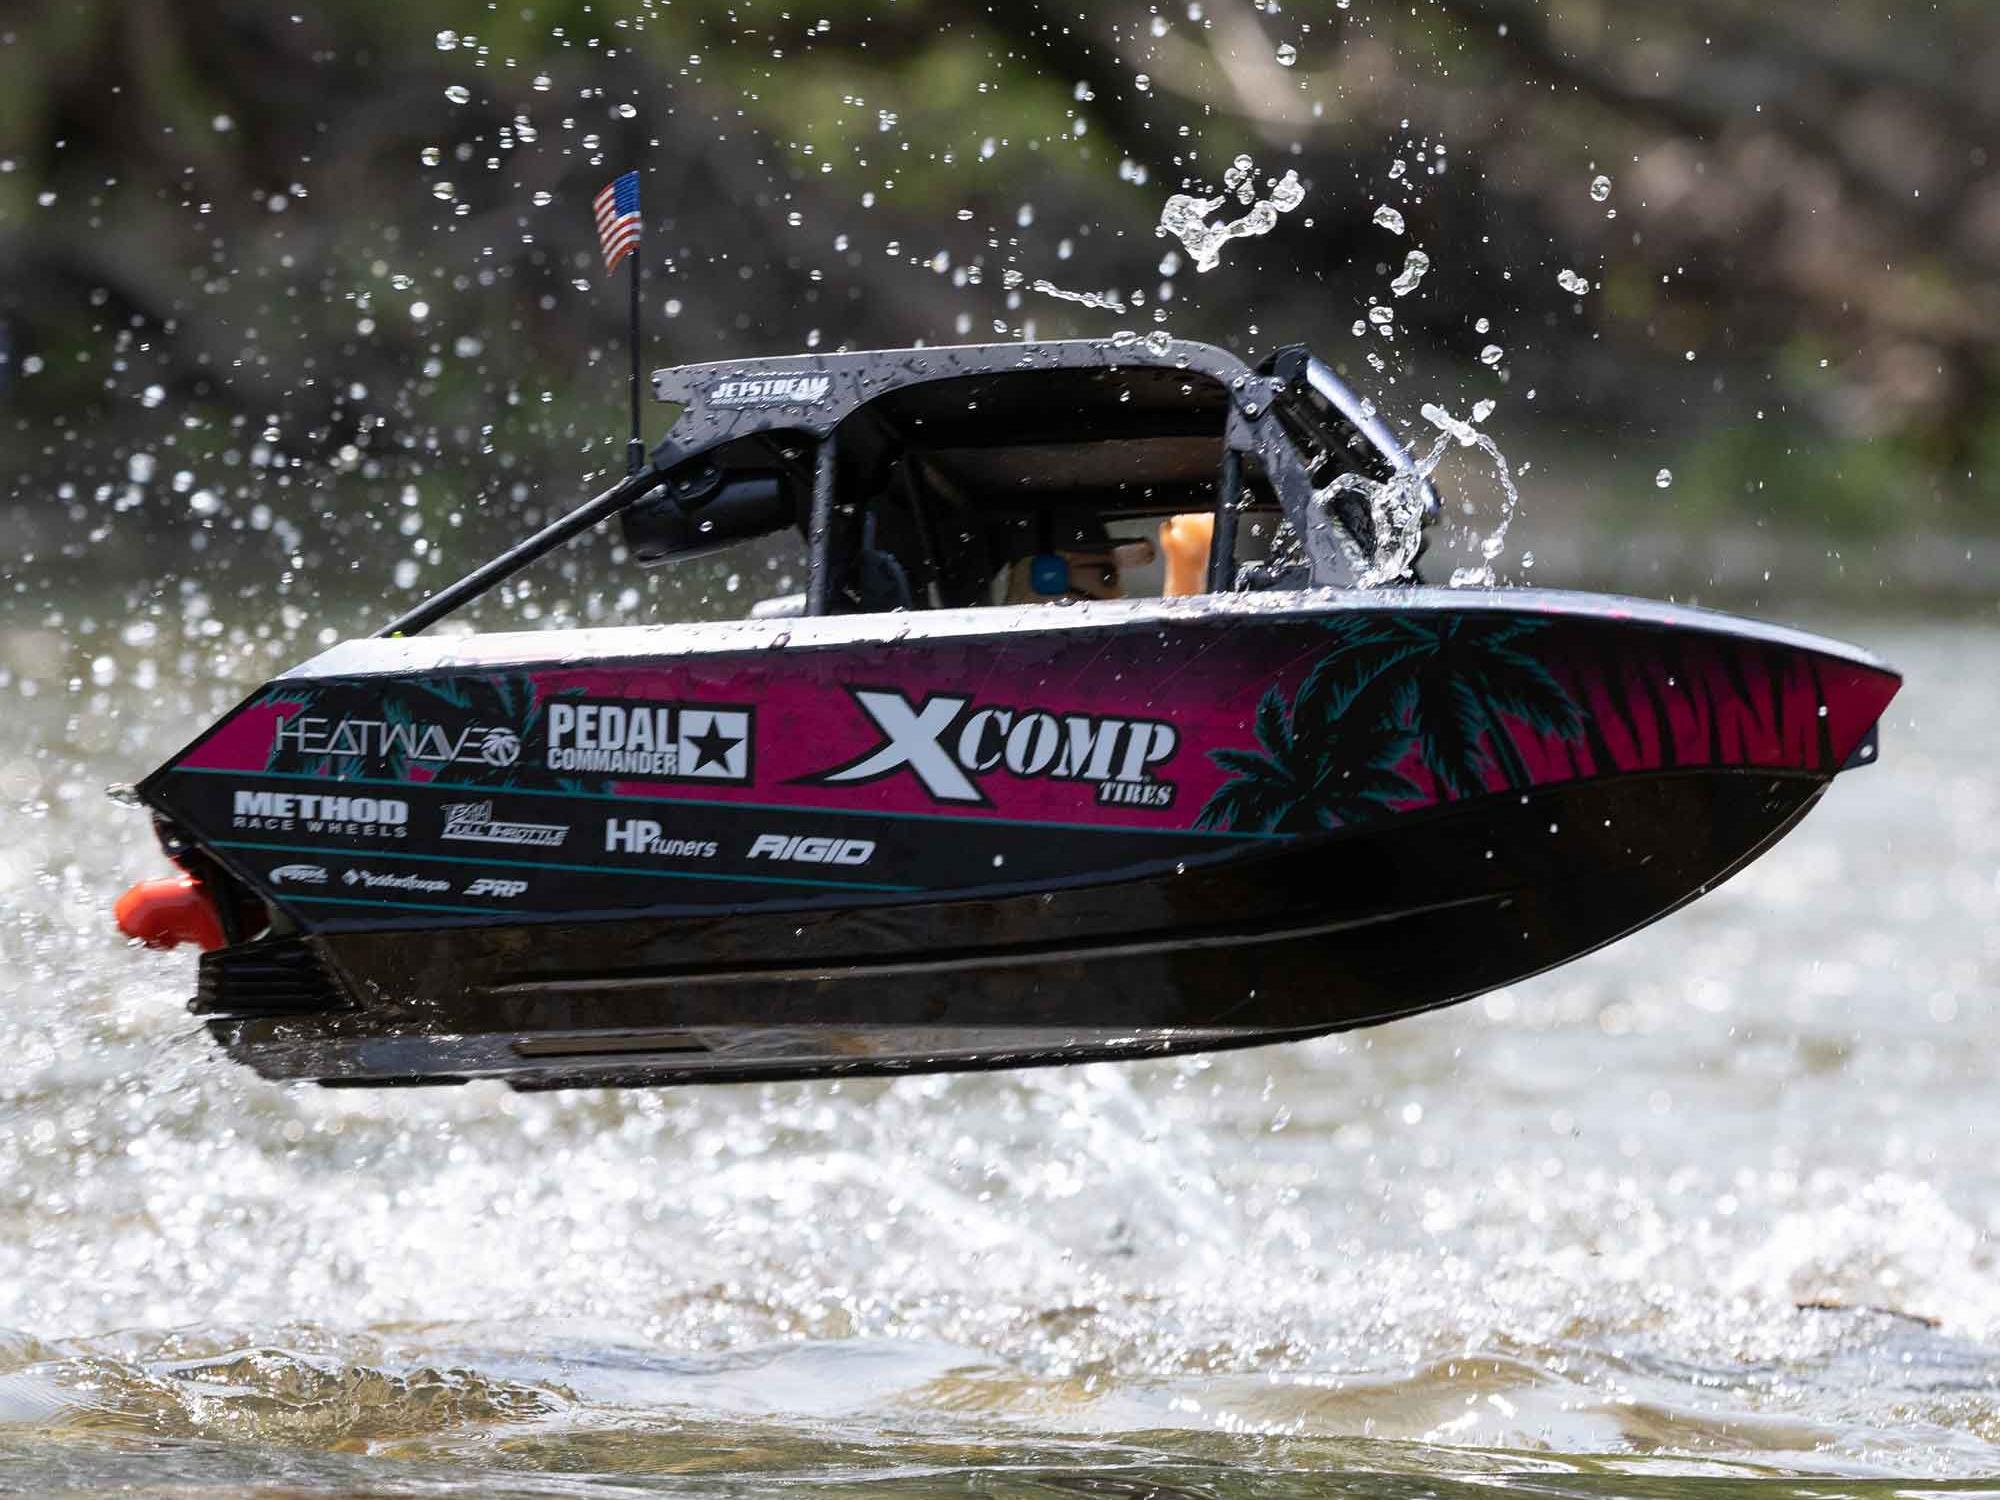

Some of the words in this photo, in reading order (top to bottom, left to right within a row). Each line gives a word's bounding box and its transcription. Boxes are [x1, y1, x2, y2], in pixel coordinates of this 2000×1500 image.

[276, 716, 491, 762] HEATWAVE
[549, 703, 679, 752] PEDAL
[548, 747, 679, 775] COMMANDER
[233, 791, 409, 825] METHOD
[1099, 781, 1173, 805] TIRES
[232, 816, 296, 831] RACE
[305, 820, 408, 838] WHEELS
[746, 834, 875, 865] RIGID
